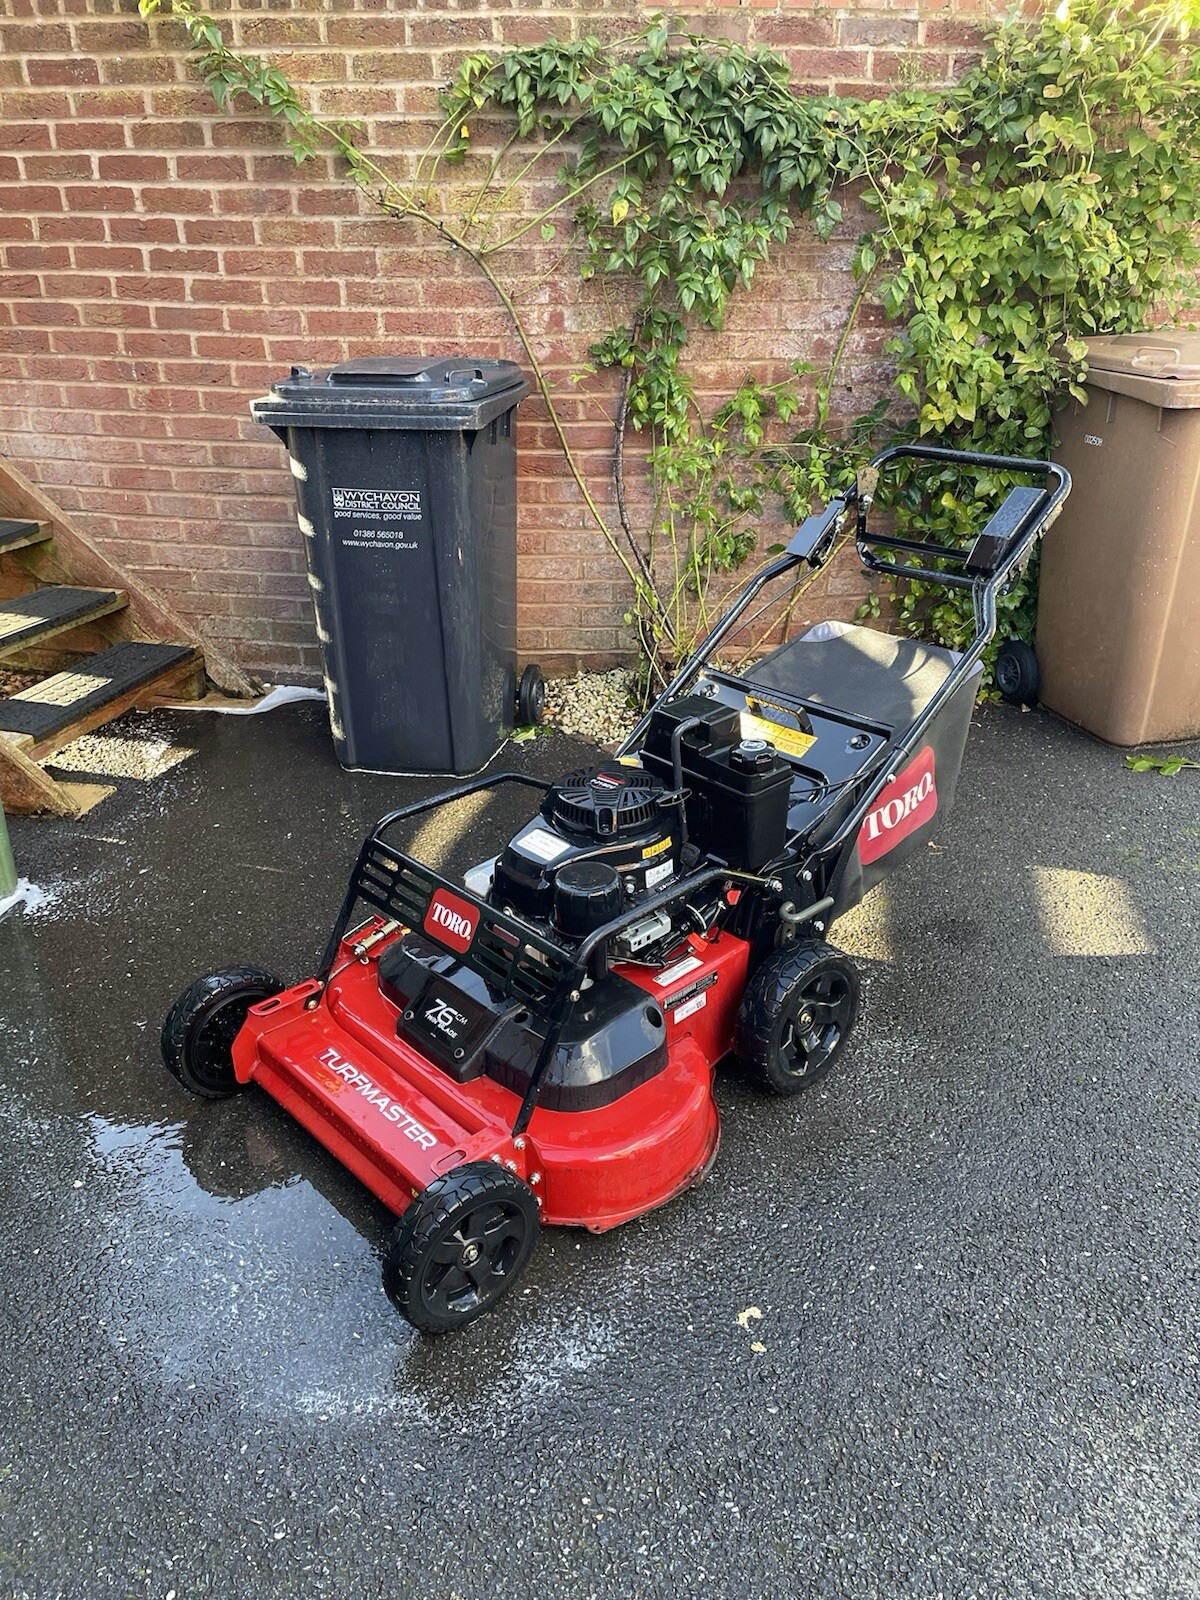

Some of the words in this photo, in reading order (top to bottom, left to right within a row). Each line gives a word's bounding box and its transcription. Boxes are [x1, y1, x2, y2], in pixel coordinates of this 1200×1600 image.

[343, 491, 420, 502] WYCHAVON
[345, 500, 379, 509] DISTRICT
[381, 502, 421, 510] COUNCIL
[352, 512, 381, 520] services,
[383, 513, 402, 521] good
[353, 529, 375, 539] 01386
[376, 531, 403, 540] 565018
[342, 540, 418, 550] www.wychavon.gov.uk
[437, 1022, 459, 1039] BLADE
[319, 1047, 438, 1151] TURFMASTER
